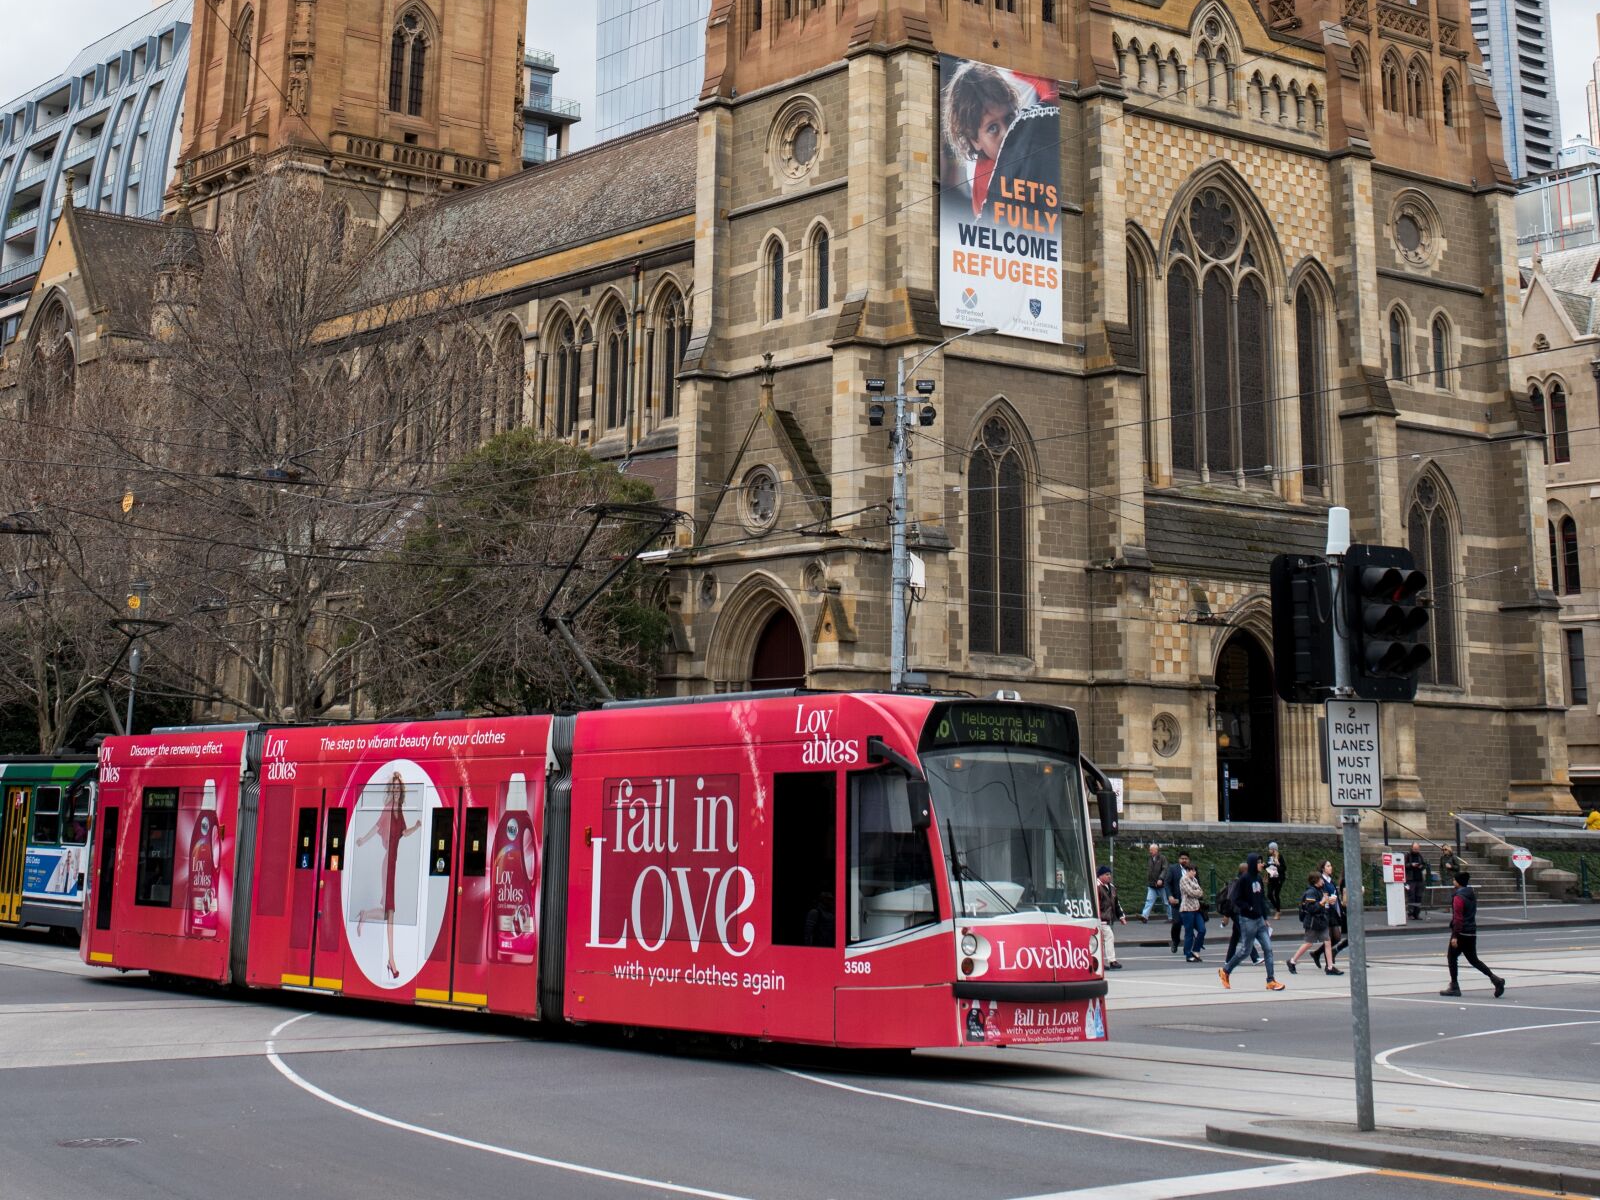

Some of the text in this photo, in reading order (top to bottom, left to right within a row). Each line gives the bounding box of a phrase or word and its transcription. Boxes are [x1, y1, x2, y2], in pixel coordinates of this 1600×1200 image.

[1000, 175, 1058, 208] LET'S
[993, 201, 1058, 234] FULLY
[958, 222, 1058, 262] WELCOME
[953, 250, 1058, 290] REFUGEES
[795, 704, 834, 734] Lov
[962, 711, 1046, 729] Melbourne Uni
[1348, 706, 1356, 719] 2
[969, 726, 1038, 742] via St Kilda
[1335, 723, 1370, 735] RIGHT
[130, 741, 223, 758] Discover the renewing effect
[265, 734, 289, 758] Lov
[320, 729, 506, 753] The step to vibrant beauty for your clothes
[802, 733, 859, 765] ables
[1333, 740, 1374, 752] LANES
[268, 757, 298, 780] ables
[1337, 757, 1371, 768] MUST
[1338, 773, 1372, 785] TURN
[1338, 788, 1373, 800] RIGHT
[612, 777, 739, 854] fall in
[585, 837, 756, 957] Love
[1064, 899, 1093, 918] 3508
[997, 939, 1090, 970] Lovables
[614, 960, 785, 995] with your clothes again
[844, 961, 871, 974] 3508
[1014, 1008, 1034, 1027] fall
[1037, 1009, 1050, 1027] in
[1052, 1008, 1079, 1026] Love
[1006, 1026, 1082, 1037] with your clothes again
